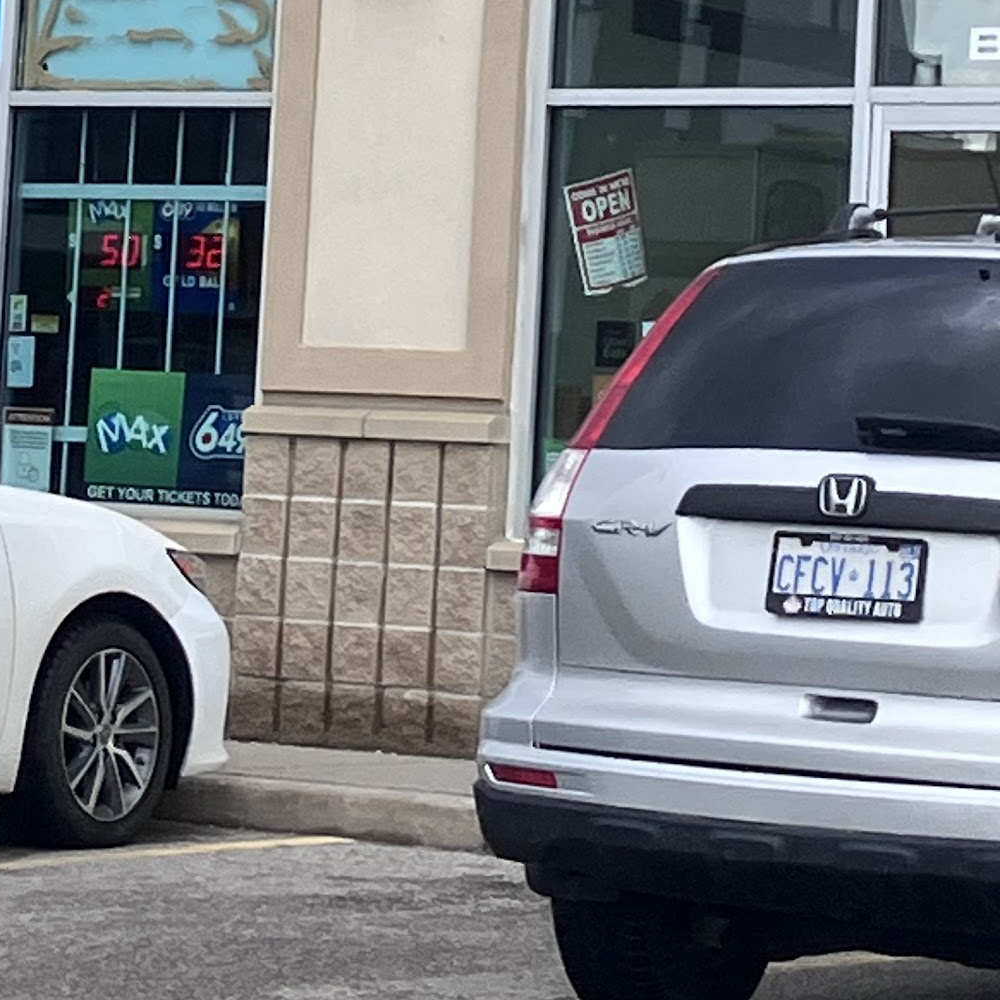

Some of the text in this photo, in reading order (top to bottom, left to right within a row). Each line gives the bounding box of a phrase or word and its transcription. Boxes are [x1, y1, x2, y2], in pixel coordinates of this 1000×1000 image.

[581, 187, 632, 222] OPEN
[96, 412, 169, 455] MAX
[87, 484, 242, 507] GET YOUR TICKETS TOD
[776, 554, 915, 600] CFCV 113
[803, 597, 902, 618] TOP QUALITY AUTO
